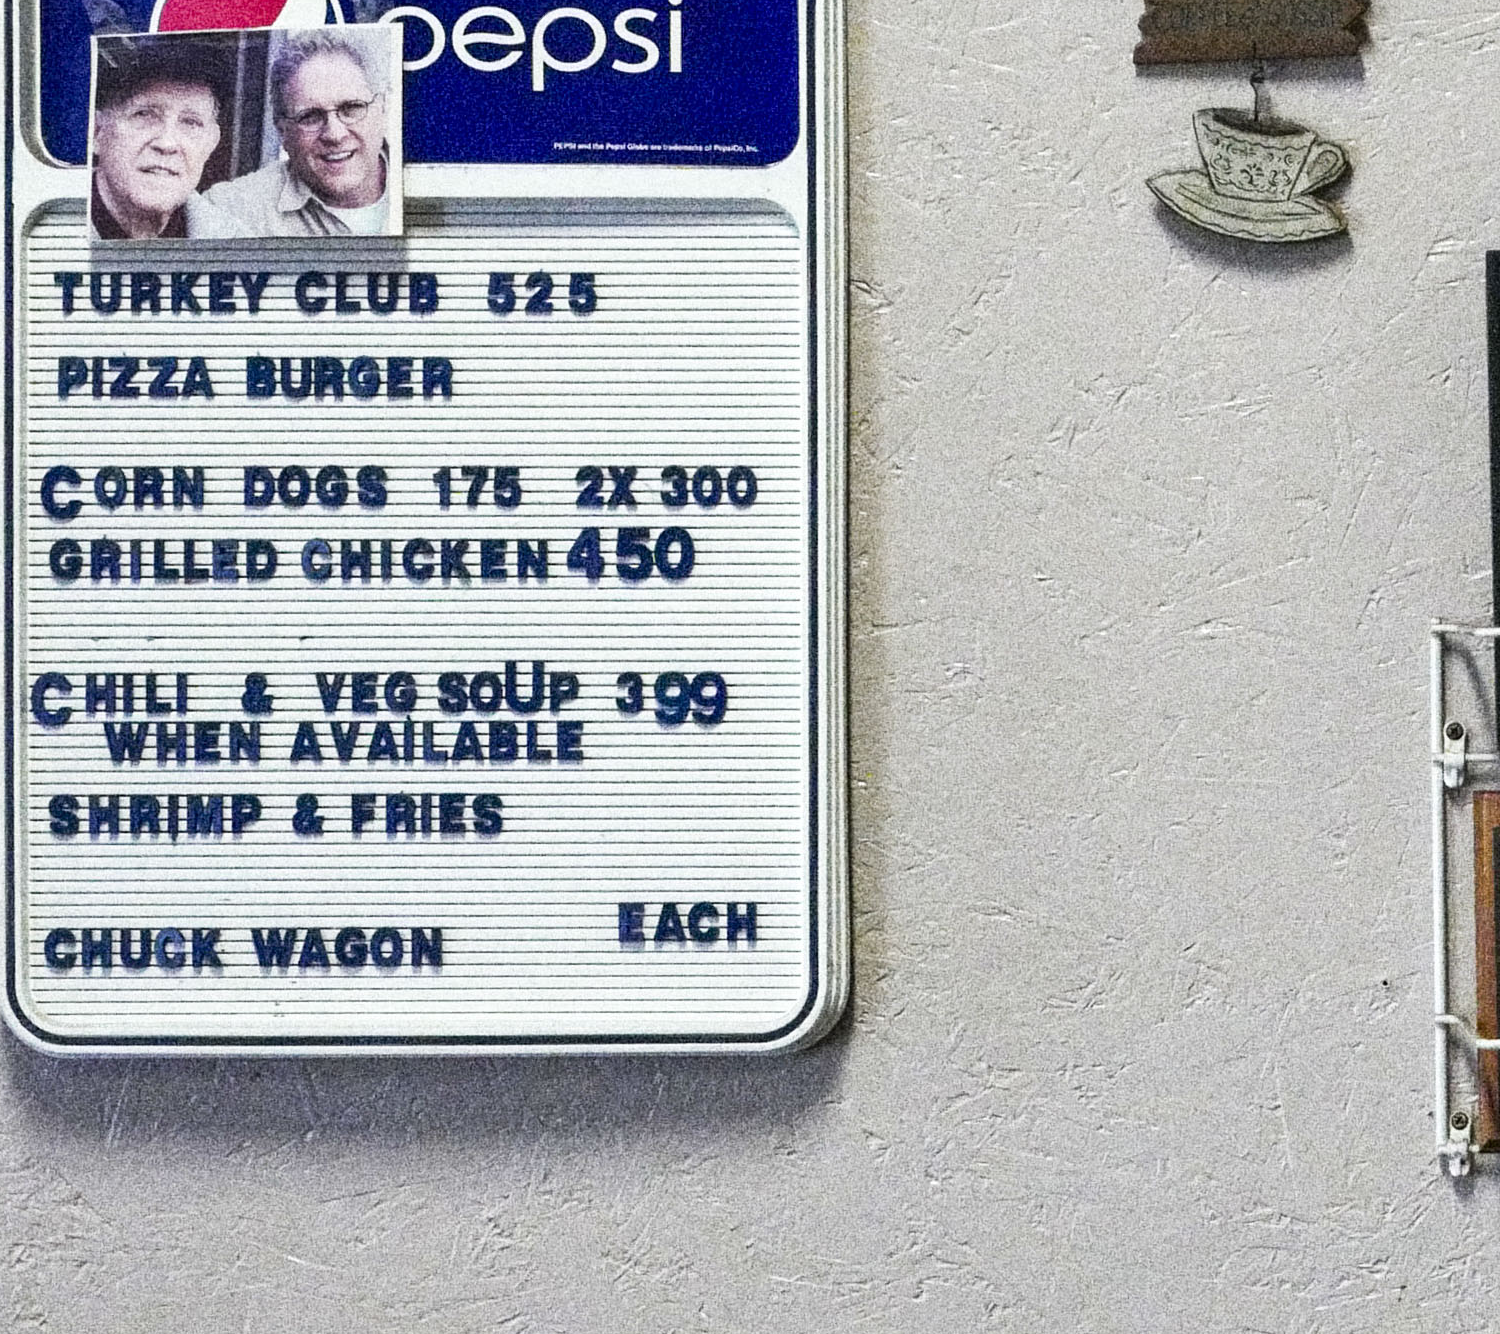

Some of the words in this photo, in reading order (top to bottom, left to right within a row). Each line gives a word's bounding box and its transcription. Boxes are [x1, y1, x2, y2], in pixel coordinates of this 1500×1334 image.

[54, 271, 272, 316] TURKEY
[295, 271, 440, 317] CLUB
[486, 271, 600, 314] 525
[57, 356, 215, 401] PIZZA
[245, 355, 454, 401] BURGER
[40, 466, 206, 521] CORN
[243, 465, 389, 509] DOGS
[431, 465, 523, 509] 175
[575, 465, 639, 509] 2X
[659, 465, 760, 509] 300
[49, 538, 279, 583] GRILLED
[300, 537, 549, 583] CHICKEN
[565, 527, 697, 583] 450
[30, 671, 190, 728] CHILI
[241, 672, 273, 716] &
[317, 671, 419, 715] VEG
[436, 660, 581, 717] SOUP
[614, 670, 729, 727] 399
[104, 719, 262, 765] WHEN
[290, 717, 586, 765] AVAILABLE
[48, 793, 264, 839] SHRIMP
[291, 794, 326, 838] &
[349, 793, 507, 839] FRIES
[43, 927, 225, 972] CHUCK
[251, 927, 447, 970] WAGON
[617, 902, 760, 946] EACH
